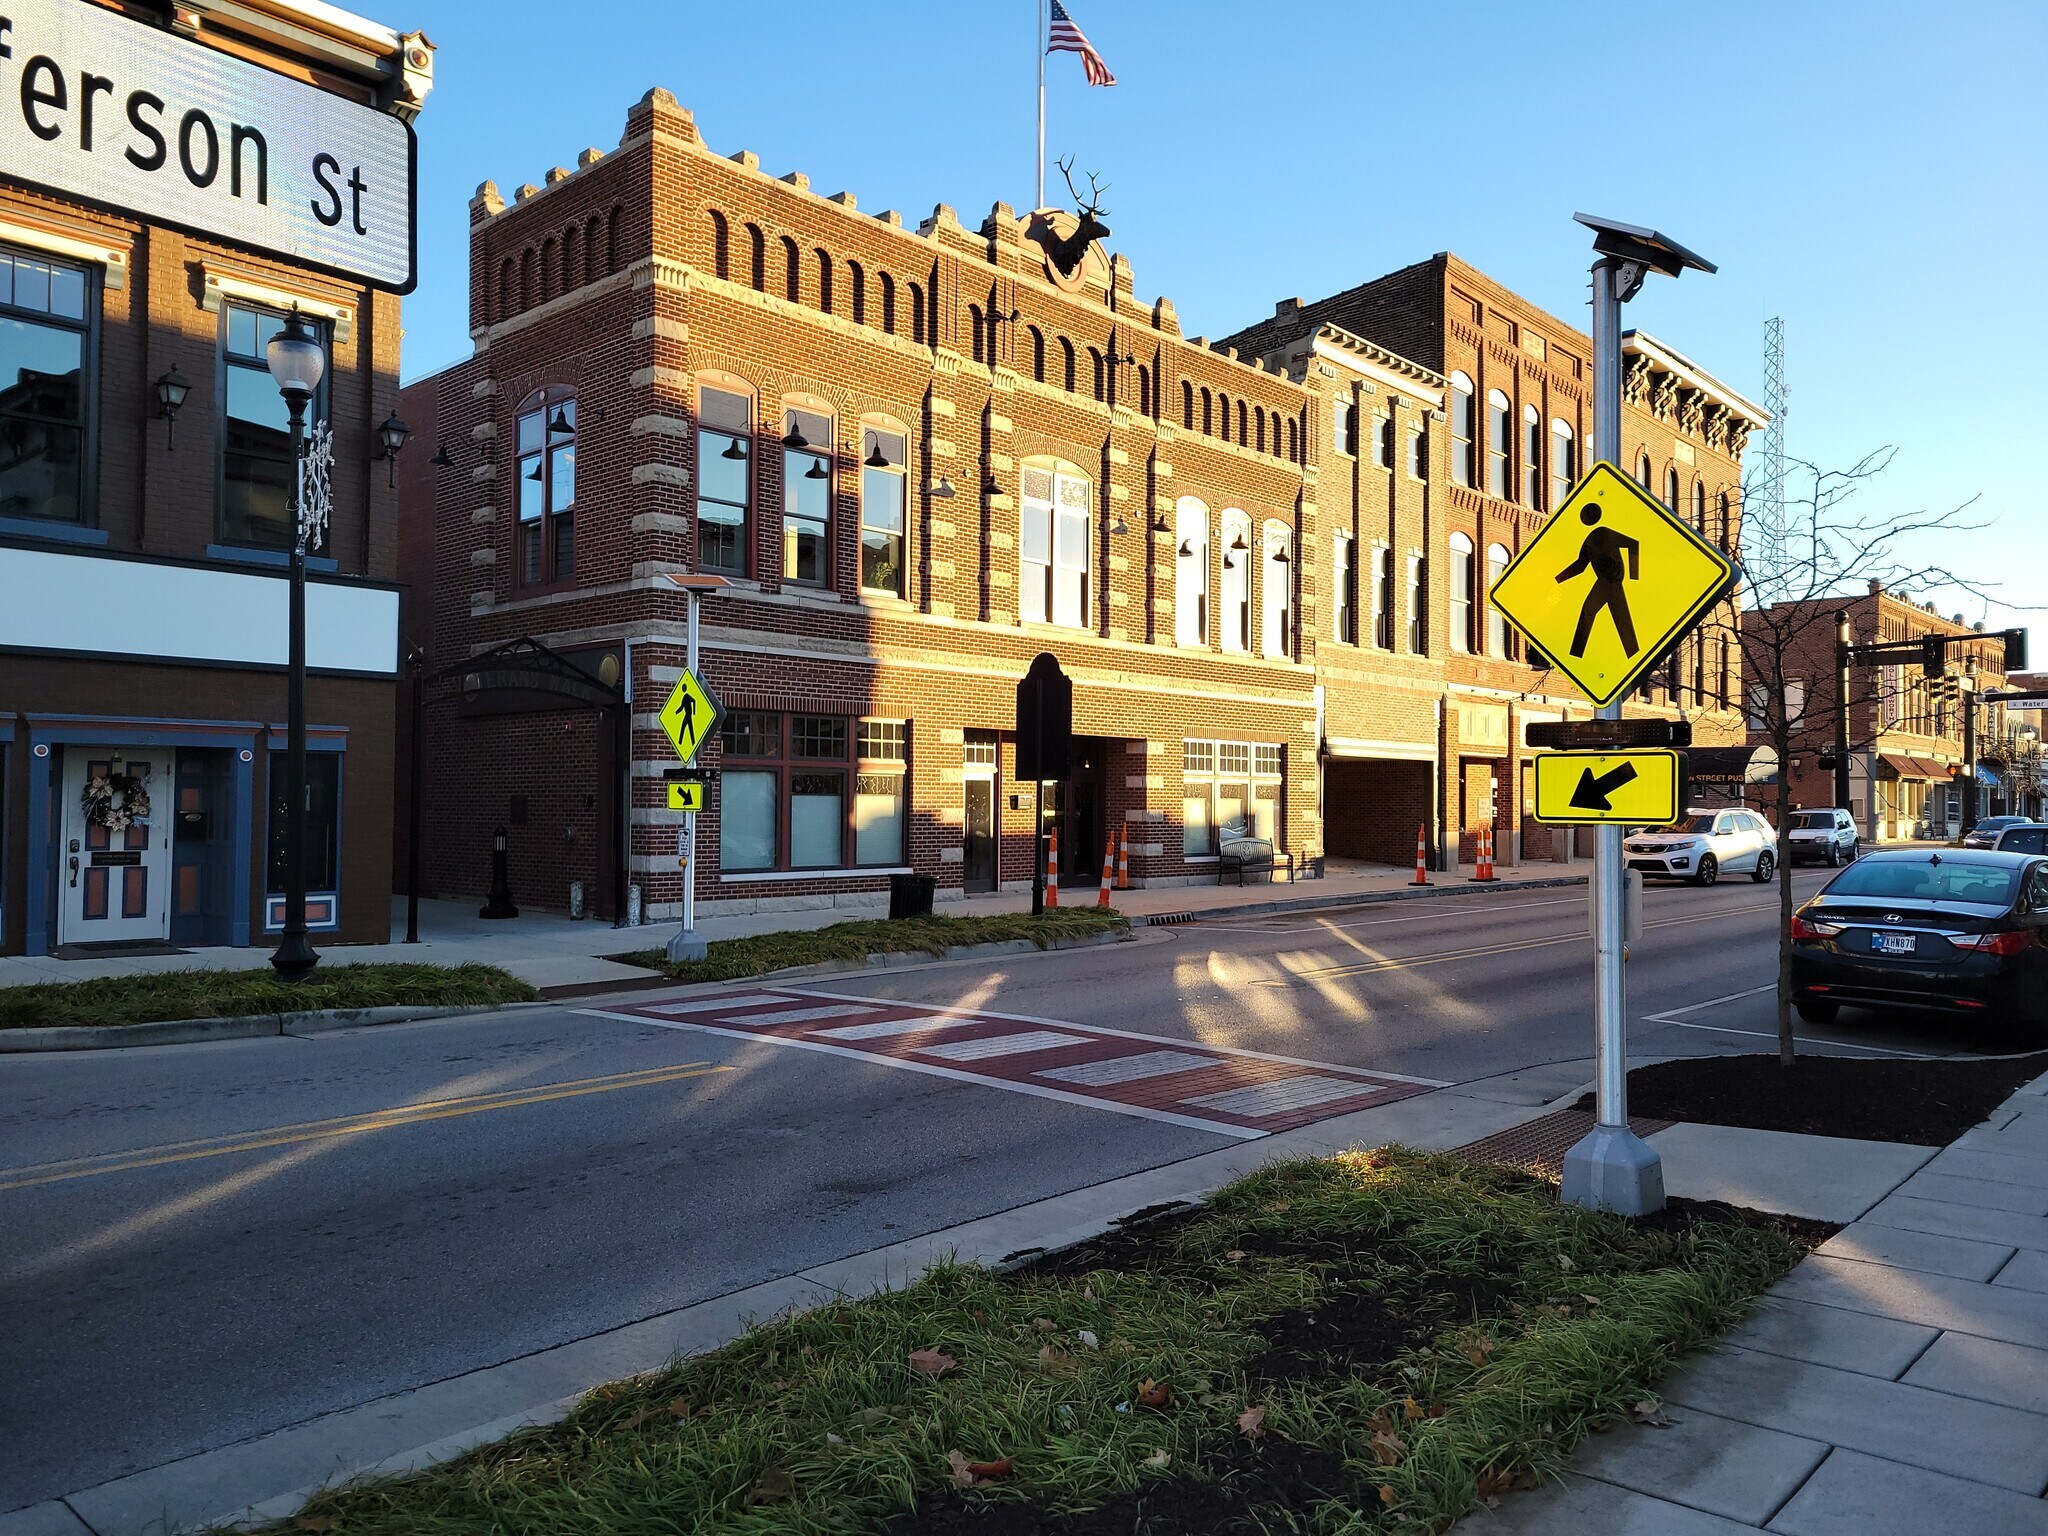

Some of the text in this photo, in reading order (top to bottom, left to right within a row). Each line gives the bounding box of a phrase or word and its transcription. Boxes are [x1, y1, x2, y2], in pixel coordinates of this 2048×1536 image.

[310, 152, 368, 236] St
[1696, 774, 1726, 782] STREET
[1885, 938, 1915, 949] XHN870
